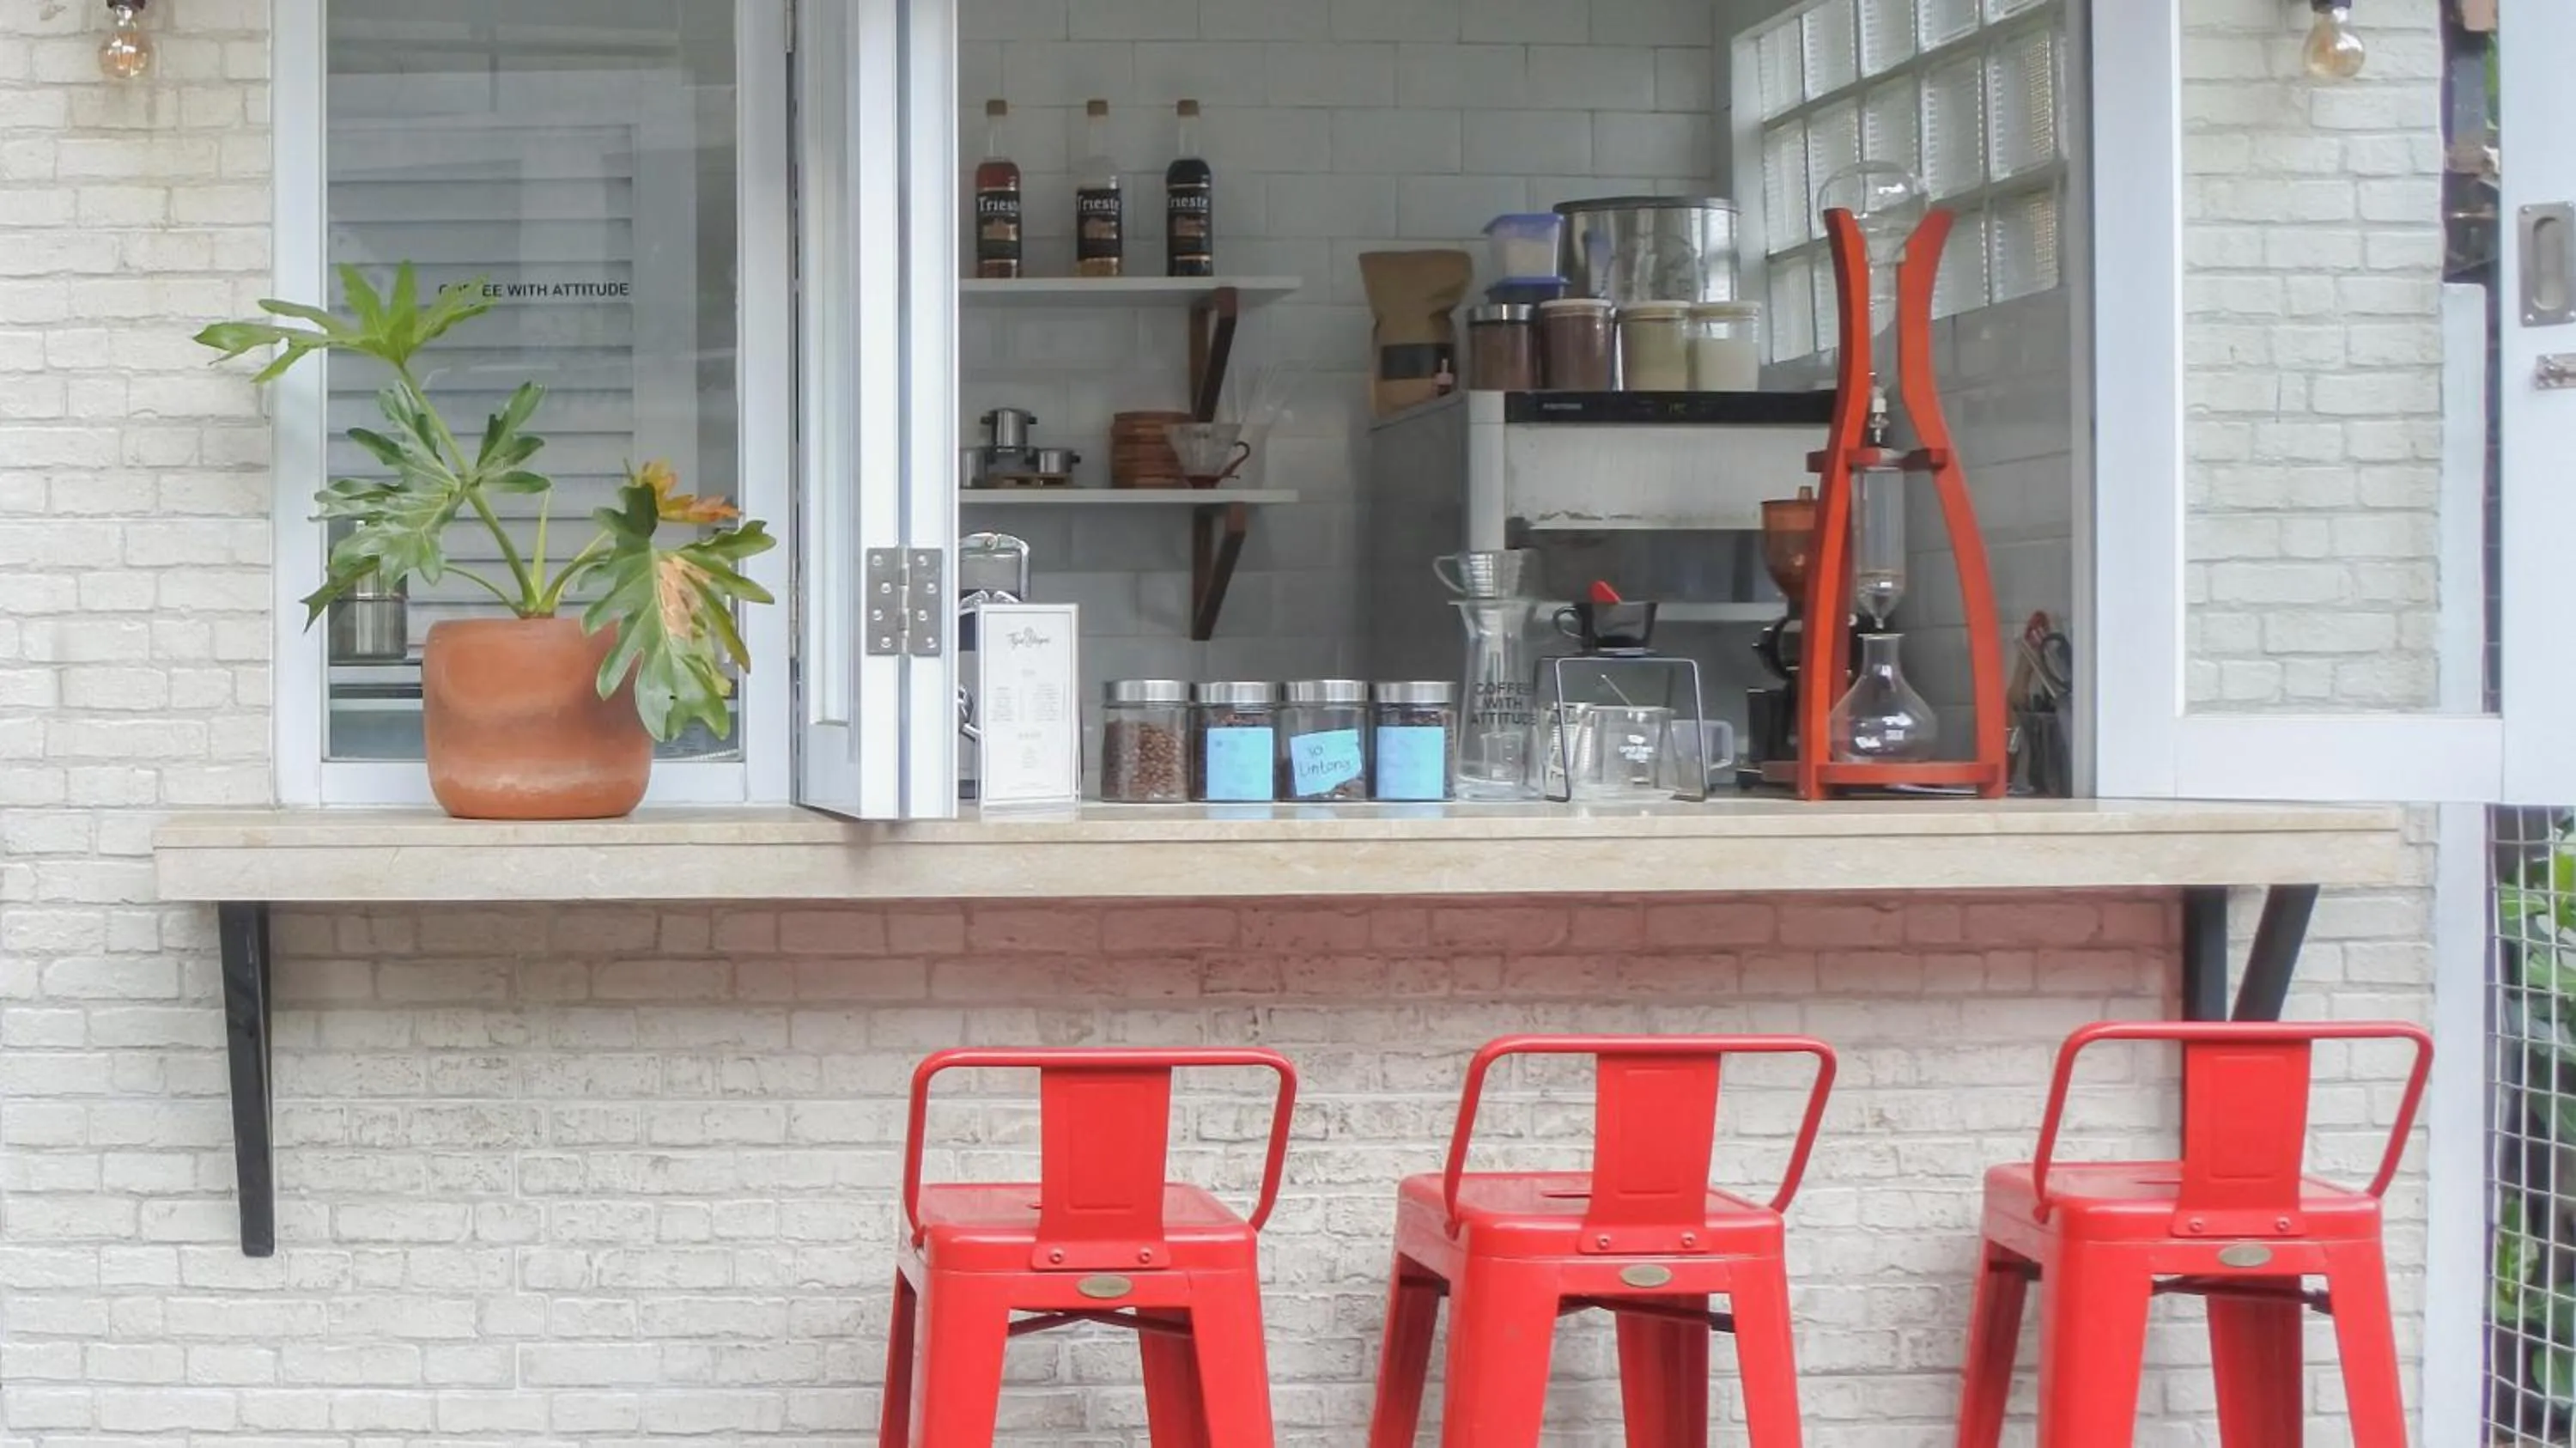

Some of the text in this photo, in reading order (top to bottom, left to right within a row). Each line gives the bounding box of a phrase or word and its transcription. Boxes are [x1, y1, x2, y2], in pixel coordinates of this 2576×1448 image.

[507, 283, 547, 296] WITH
[552, 283, 629, 296] ATTITUDE
[1484, 697, 1523, 709] WITH
